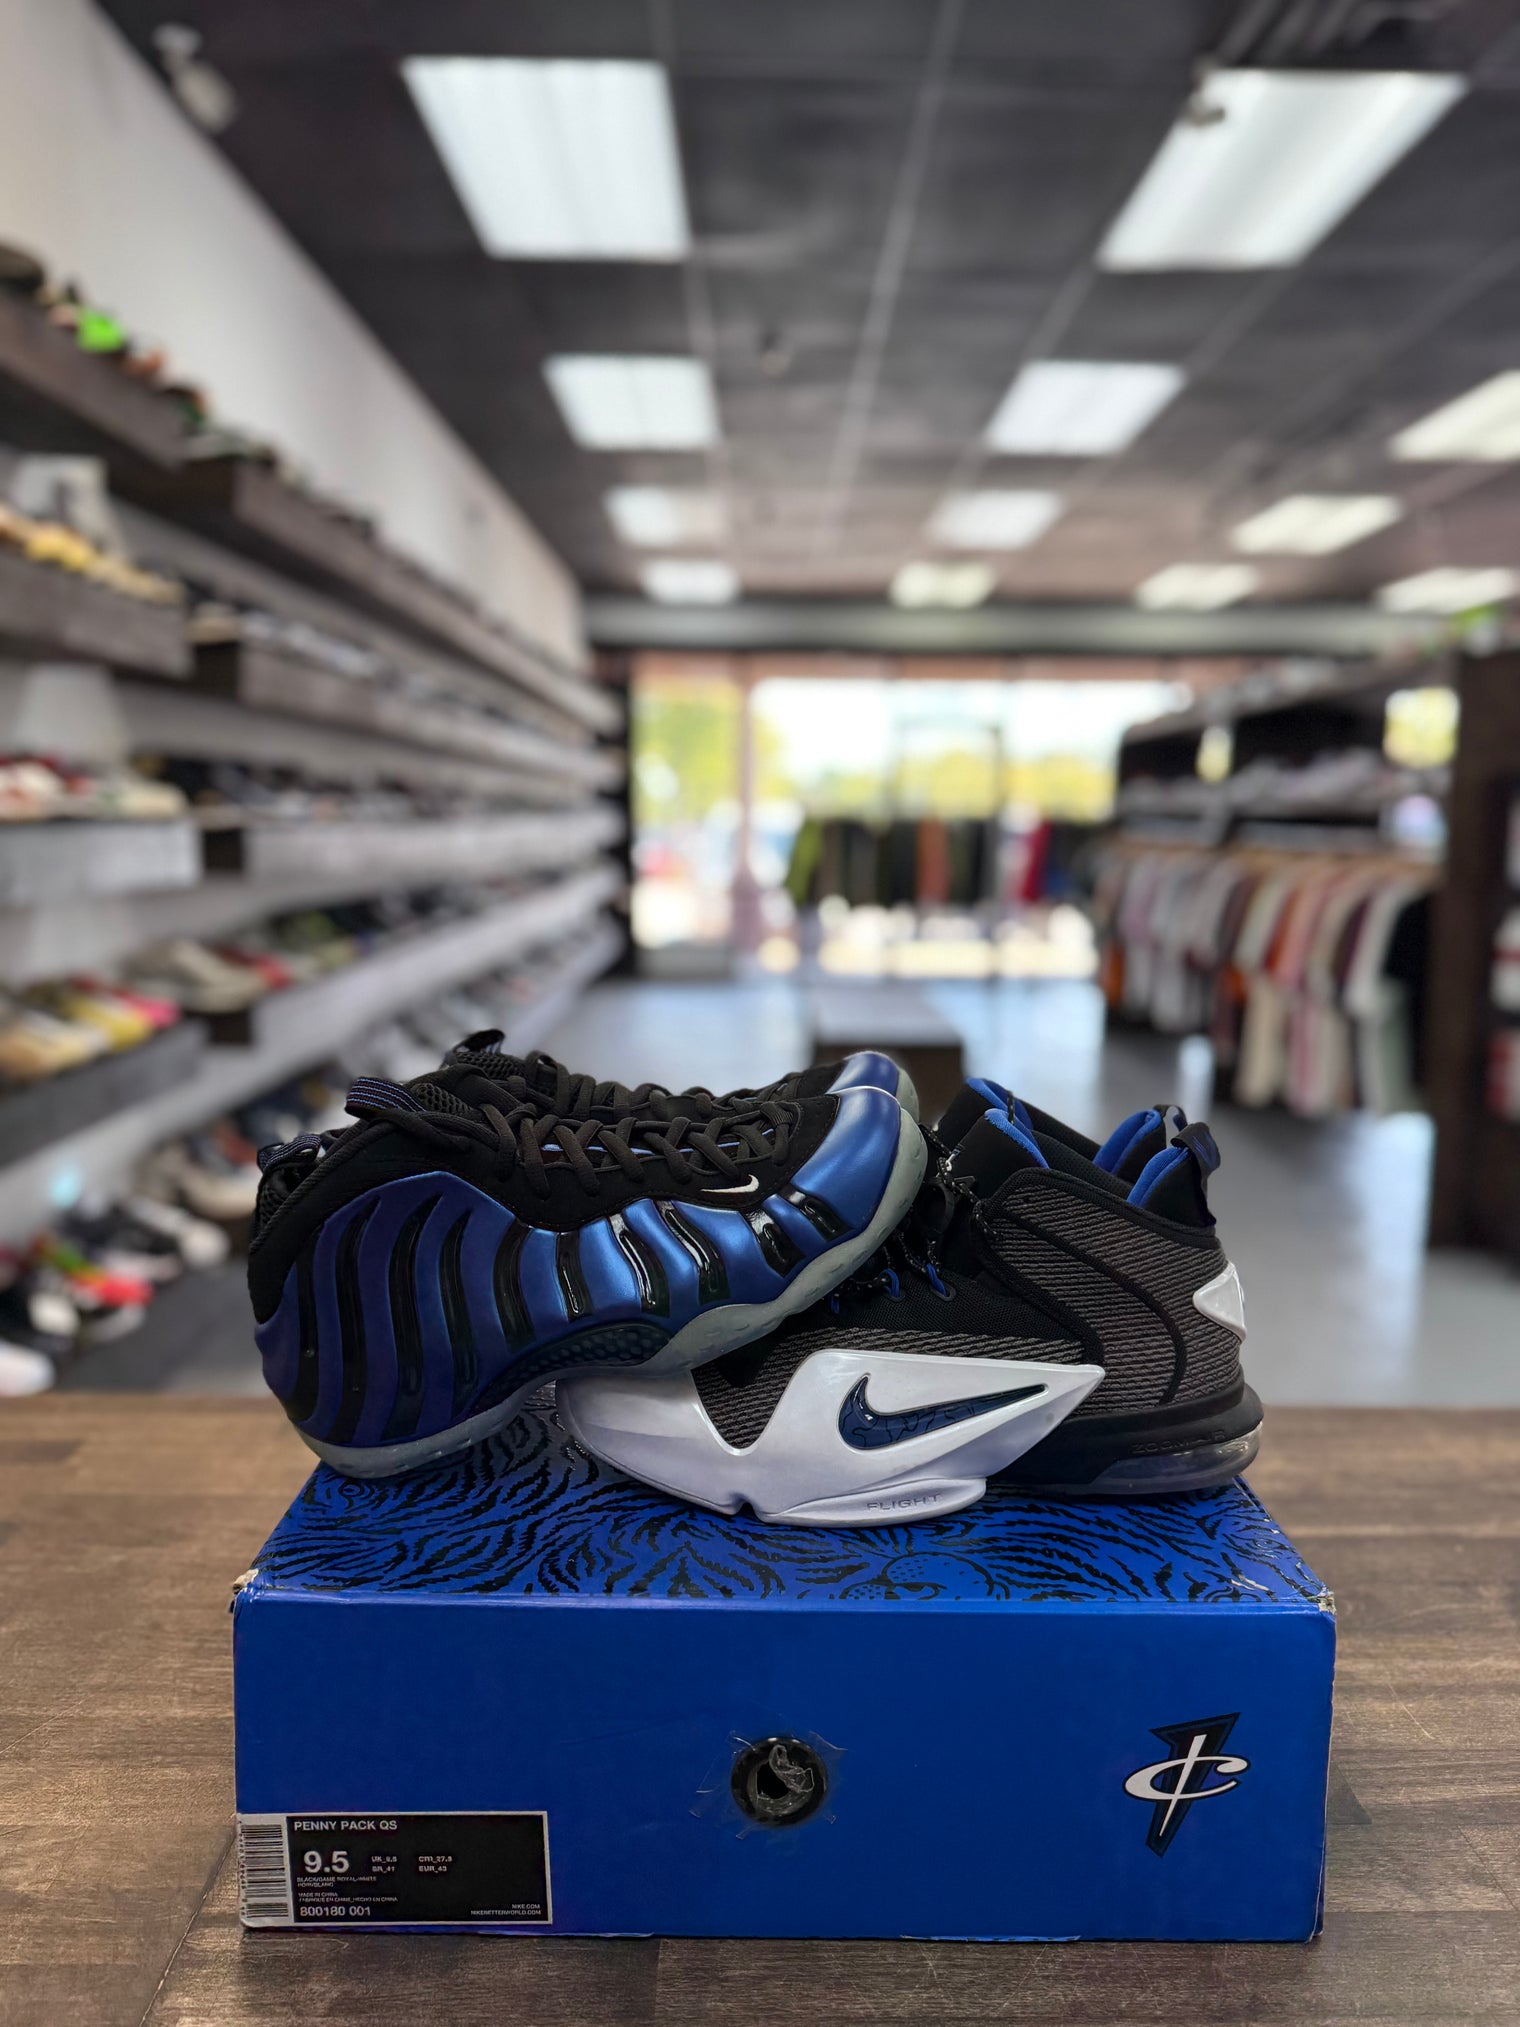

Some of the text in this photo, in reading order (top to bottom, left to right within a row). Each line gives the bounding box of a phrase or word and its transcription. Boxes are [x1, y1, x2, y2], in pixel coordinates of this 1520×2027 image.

[866, 1493, 941, 1511] FLIGHT
[294, 1820, 398, 1831] PENNY PACK QS
[303, 1850, 350, 1873] 9.5
[300, 1905, 371, 1917] 800180 001
